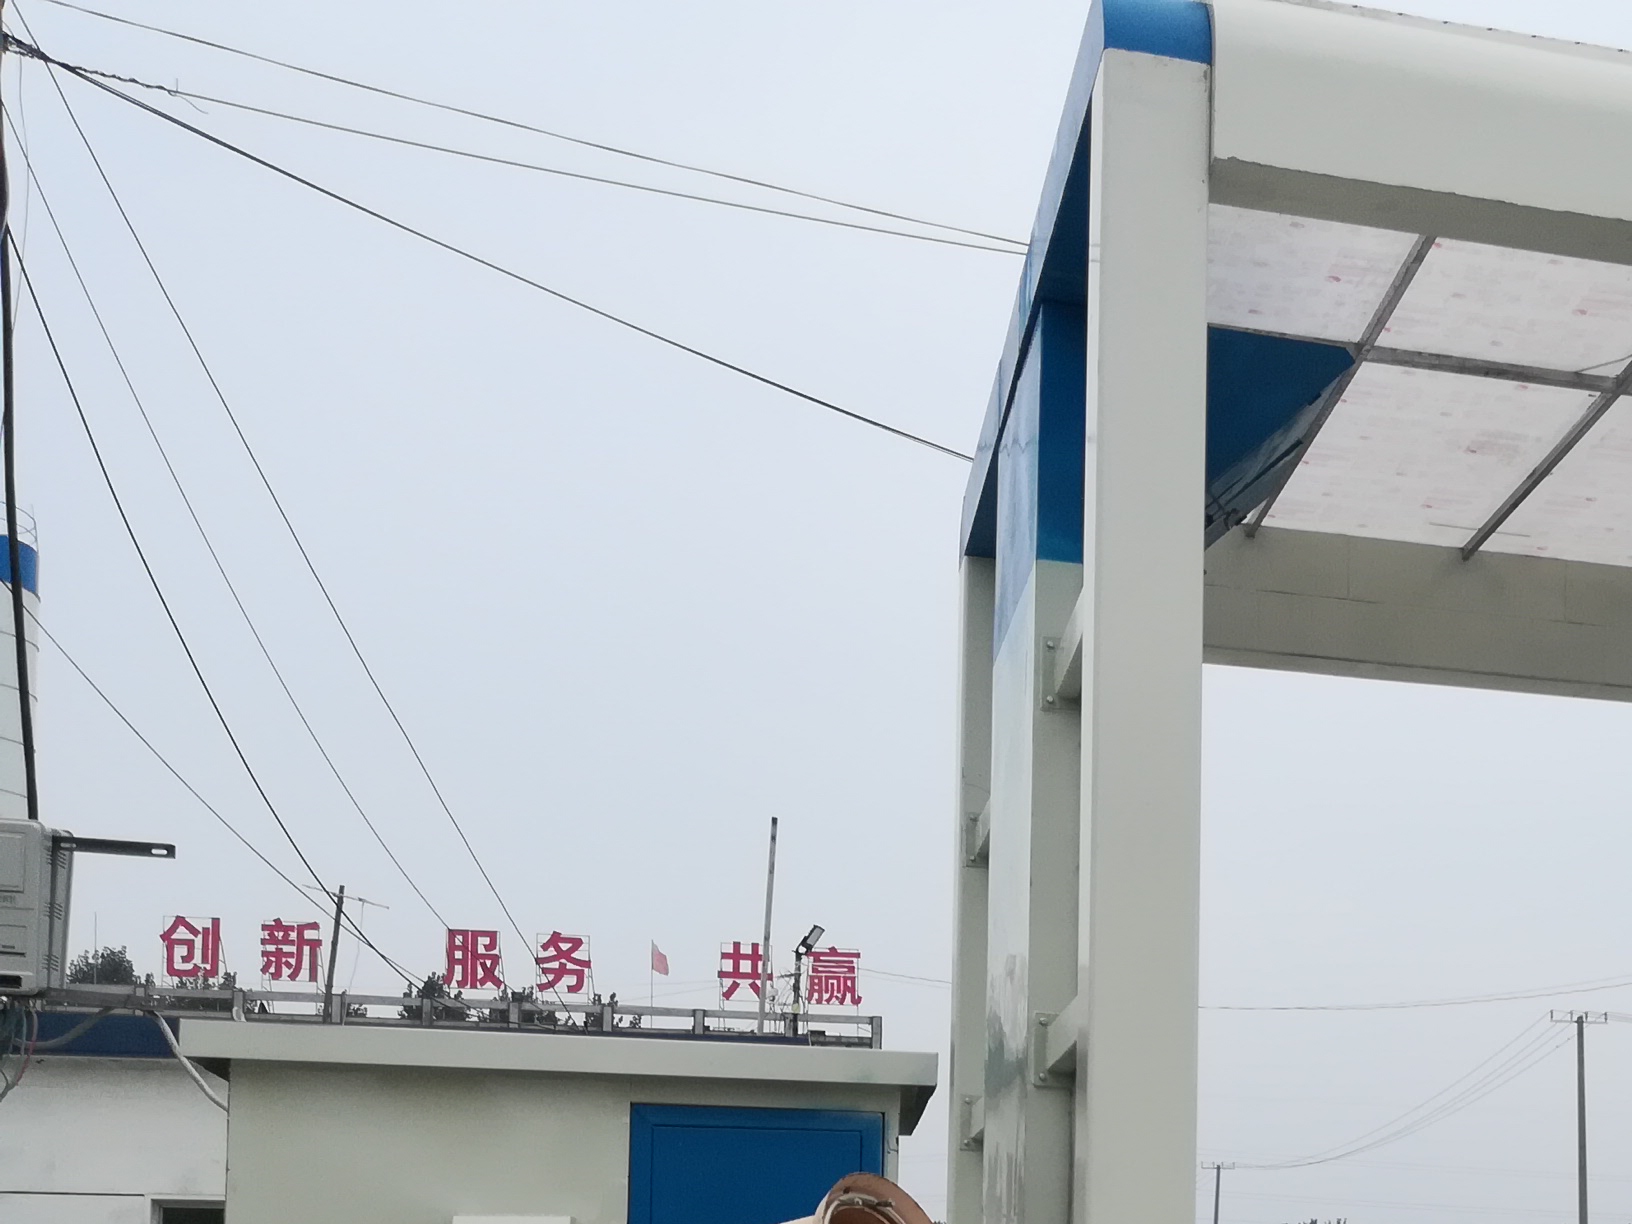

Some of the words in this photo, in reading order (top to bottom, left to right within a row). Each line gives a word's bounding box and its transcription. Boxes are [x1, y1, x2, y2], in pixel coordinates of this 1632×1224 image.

[160, 915, 322, 982] 创新
[443, 929, 591, 993] 服务
[718, 941, 862, 1005] 共赢
